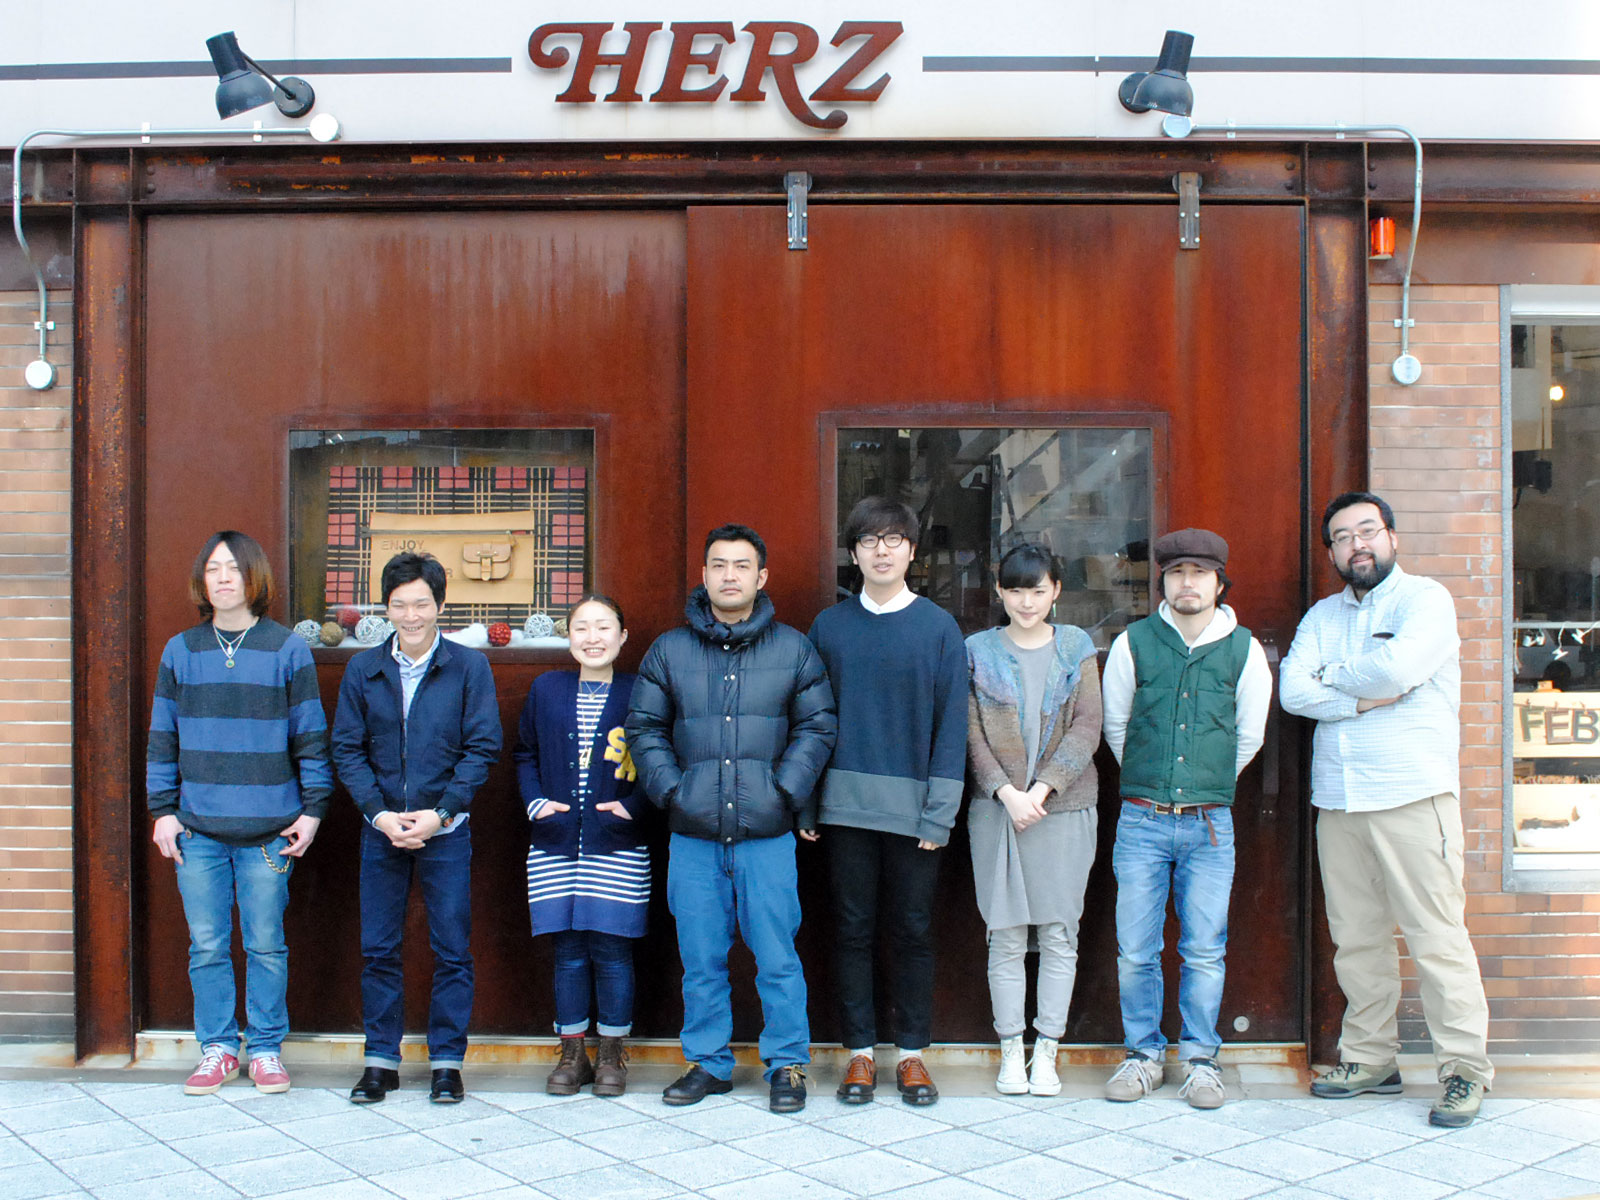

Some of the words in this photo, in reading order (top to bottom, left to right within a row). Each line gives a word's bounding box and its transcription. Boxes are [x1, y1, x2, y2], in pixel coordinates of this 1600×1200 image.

[527, 21, 905, 130] HERZ
[381, 539, 425, 551] ENJOY
[1519, 705, 1599, 745] FEB
